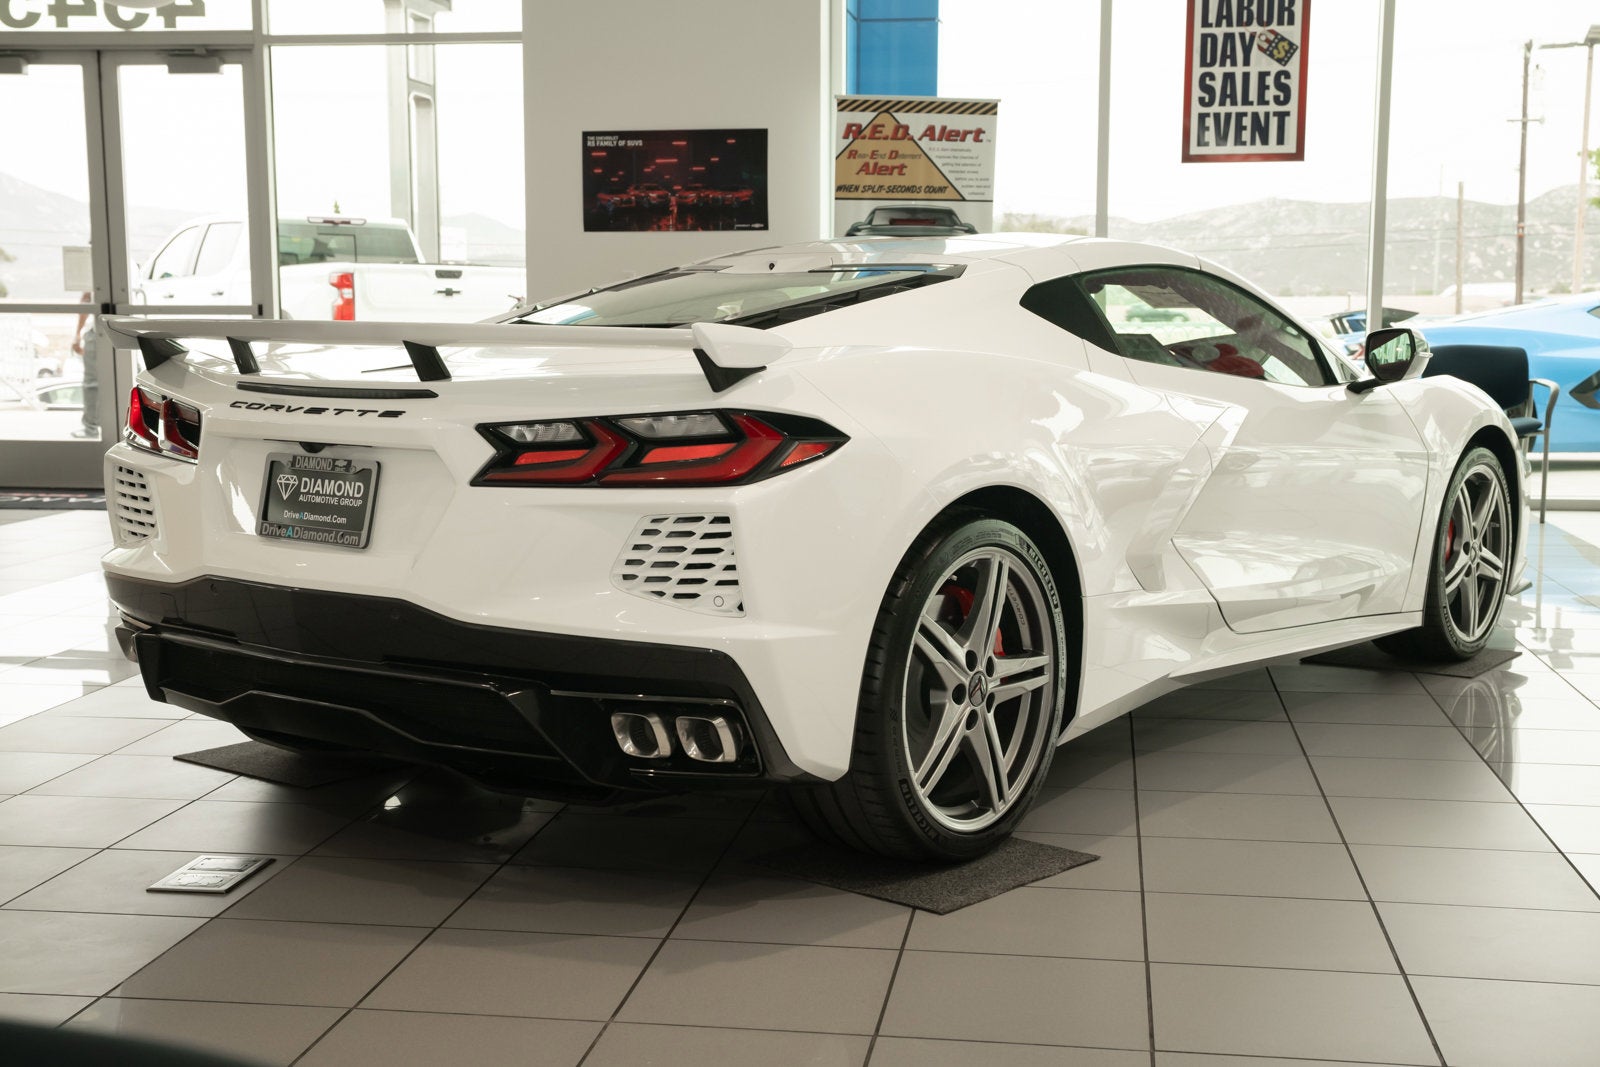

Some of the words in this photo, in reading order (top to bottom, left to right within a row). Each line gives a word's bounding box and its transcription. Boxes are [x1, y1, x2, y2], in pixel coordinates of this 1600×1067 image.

[1201, 0, 1295, 28] LABOR
[1199, 32, 1257, 68] DAY
[1198, 70, 1292, 108] SALES
[842, 123, 914, 141] R.E.D.
[918, 125, 985, 143] Alert
[1197, 111, 1291, 147] EVENT
[856, 161, 908, 176] Alert
[836, 184, 860, 193] WHEN
[861, 185, 922, 194] SPLIT-SECONDS
[924, 186, 949, 194] COUNT
[229, 401, 406, 418] CORVETTE
[295, 456, 333, 471] DIAMOND
[300, 477, 364, 498] DIAMOND
[298, 494, 339, 505] AUTOMOTIVE
[339, 498, 363, 507] GROUP
[283, 510, 347, 524] DriveADiamond.Com
[262, 522, 360, 546] DriveADiamond.Com
[1027, 549, 1058, 608] MICHELIN
[900, 781, 938, 843] MICHELIN
